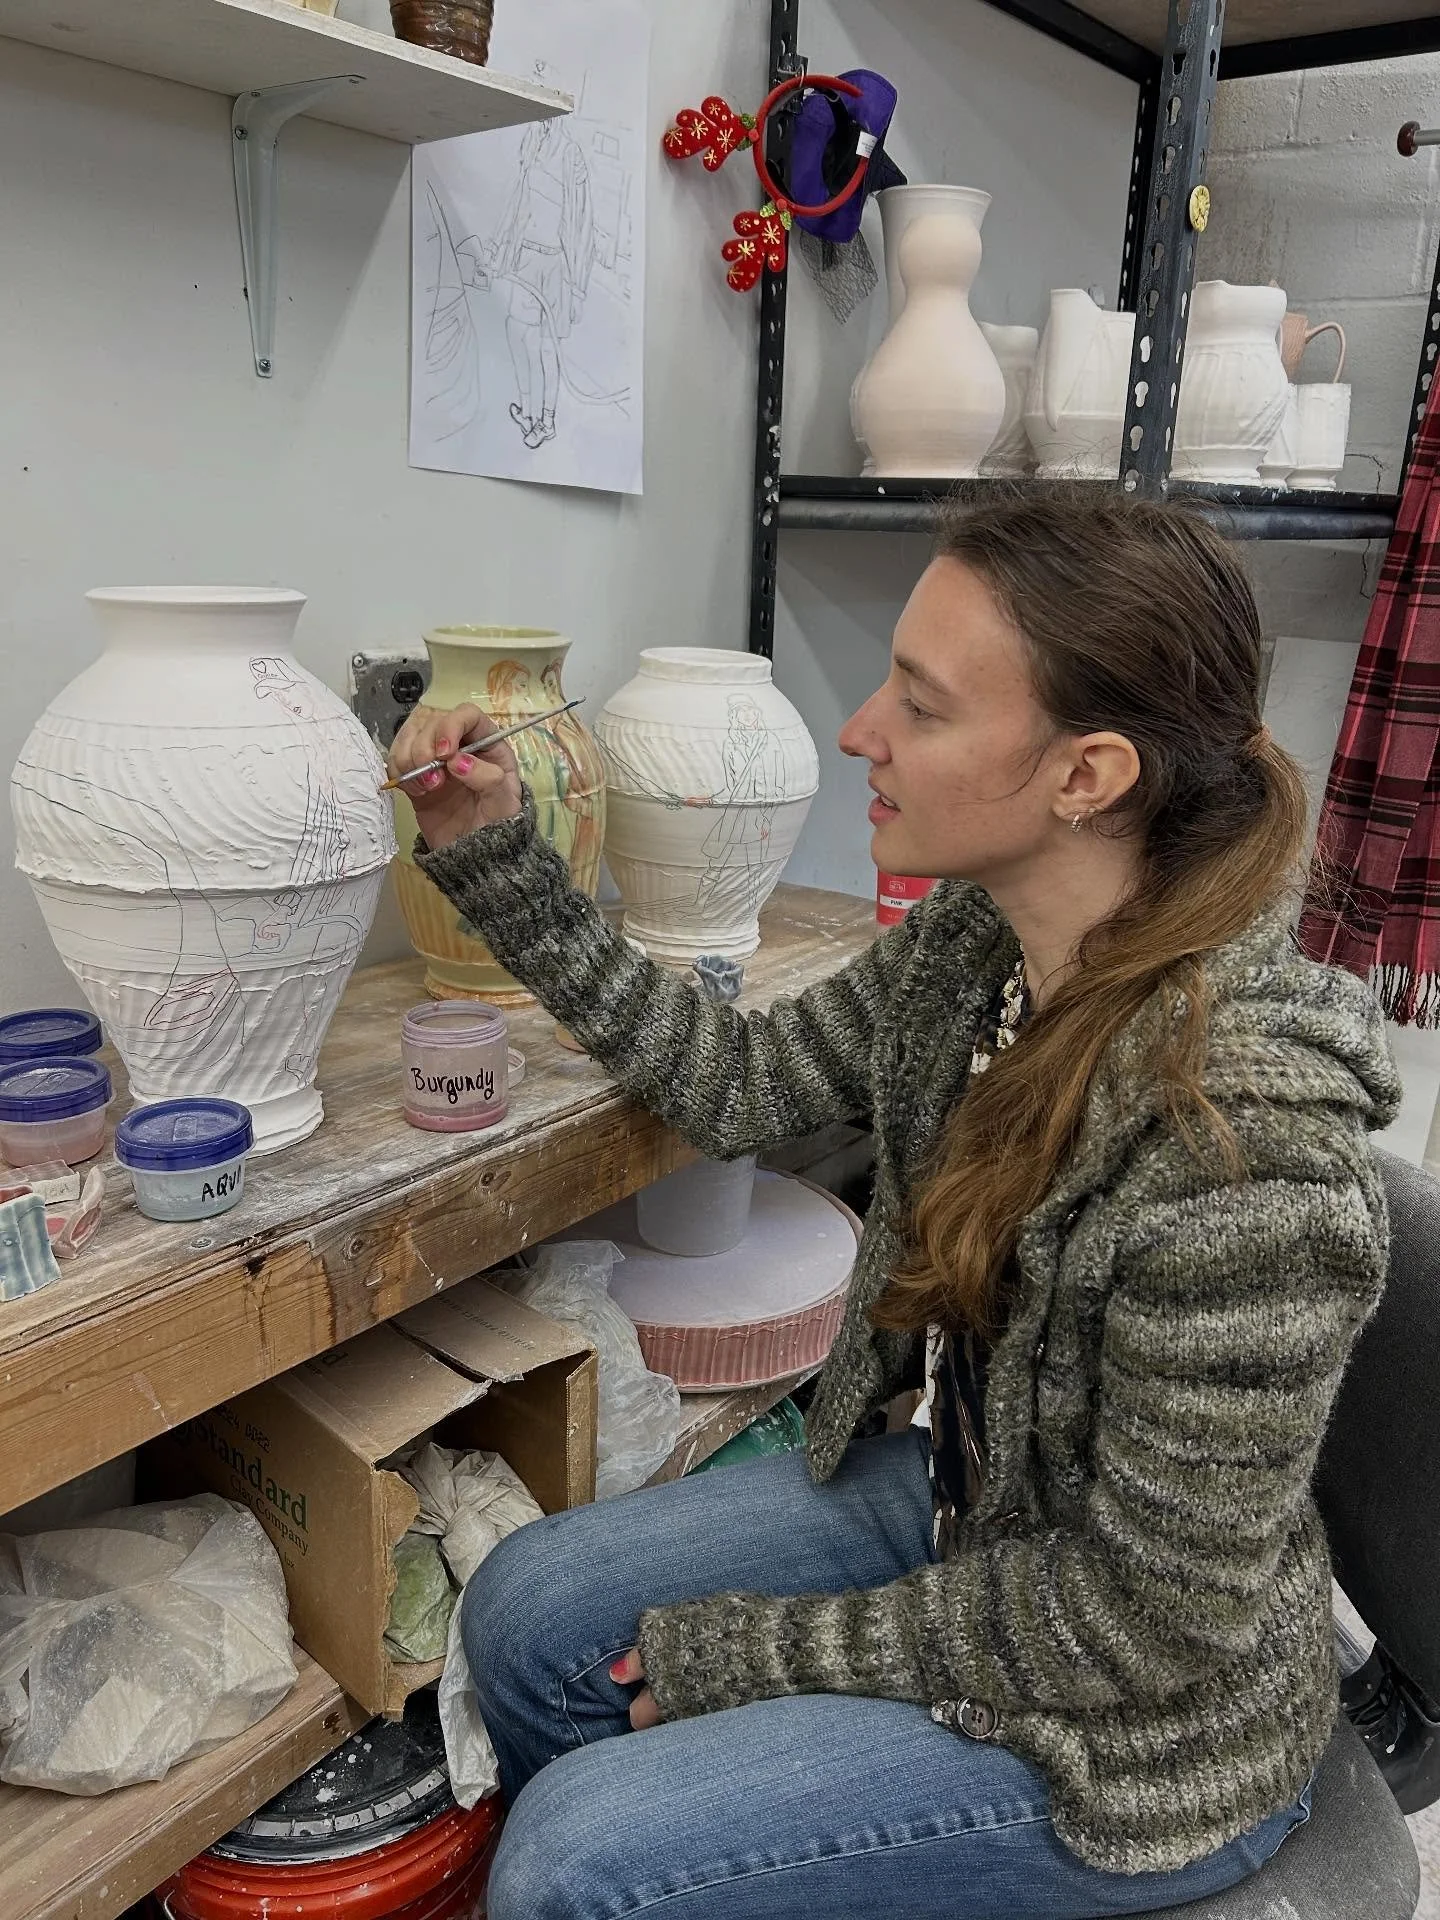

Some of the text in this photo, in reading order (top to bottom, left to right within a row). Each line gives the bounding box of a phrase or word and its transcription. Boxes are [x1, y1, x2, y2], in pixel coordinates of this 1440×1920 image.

[411, 1067, 494, 1104] Burgundy
[194, 1418, 309, 1533] Standard
[231, 1474, 309, 1557] Clay Company
